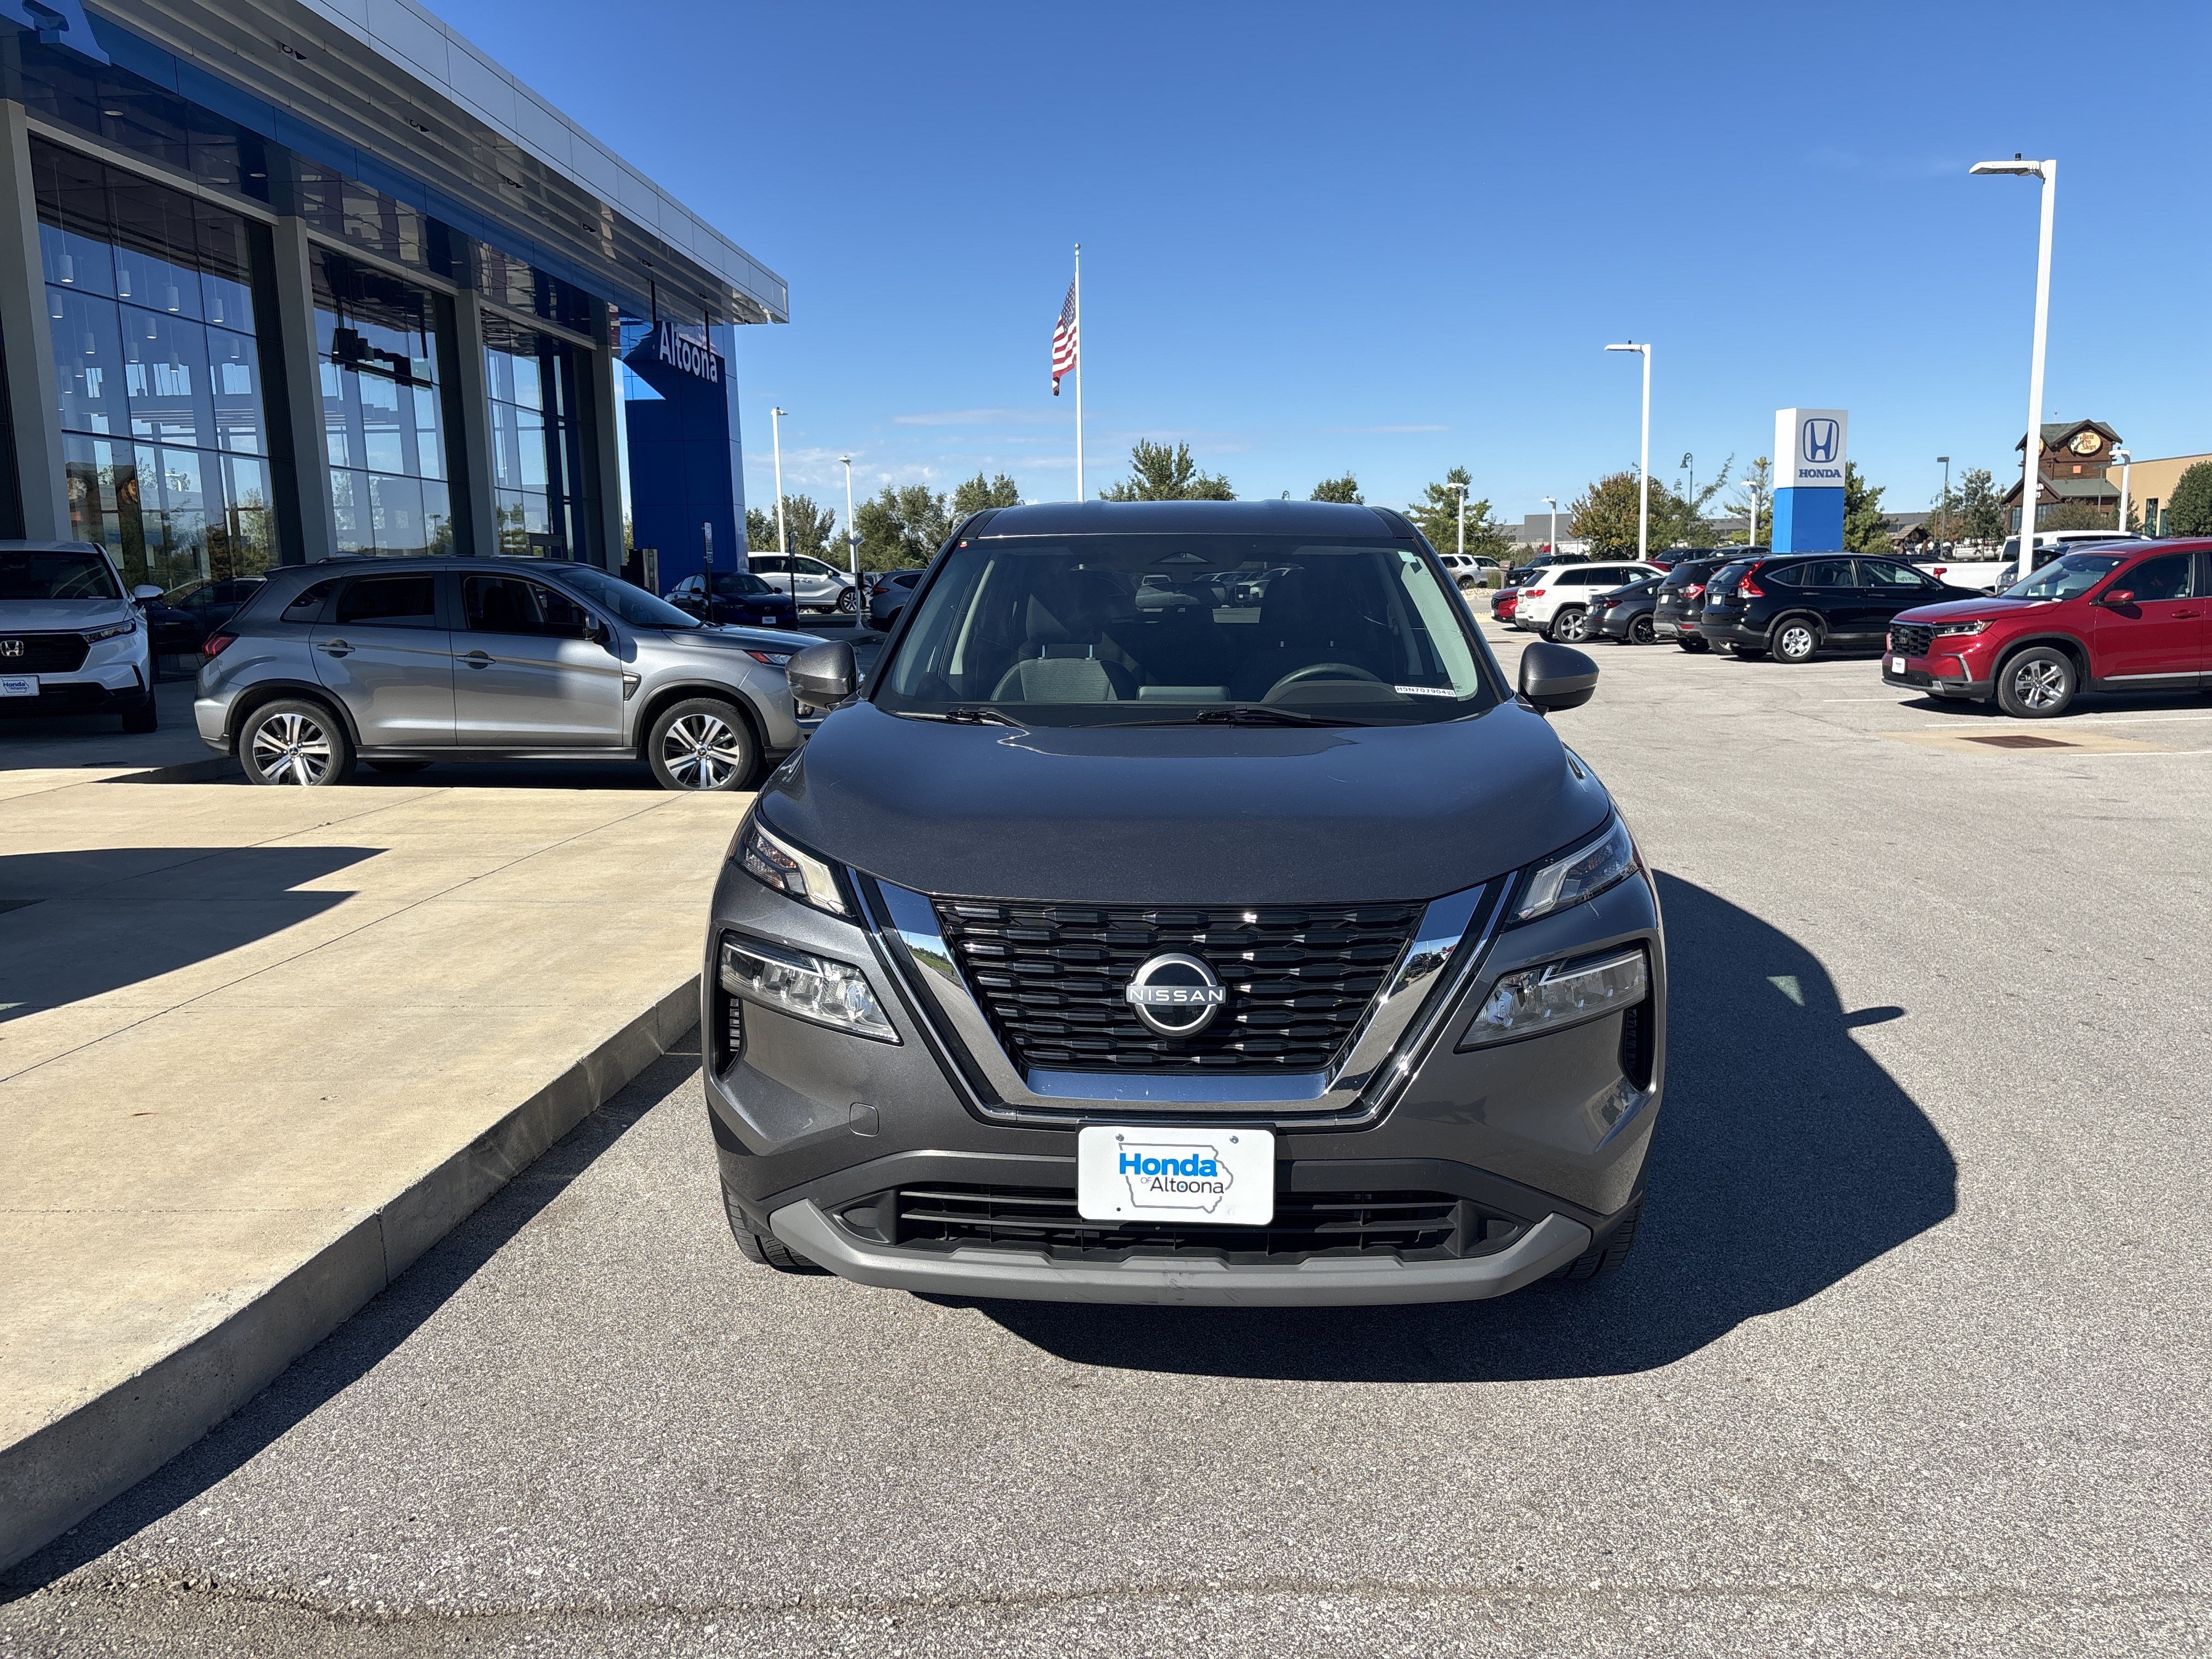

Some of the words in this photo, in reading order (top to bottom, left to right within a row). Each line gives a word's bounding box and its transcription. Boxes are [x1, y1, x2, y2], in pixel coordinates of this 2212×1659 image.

[659, 321, 718, 383] Altoona
[1798, 469, 1842, 478] HONDA
[1130, 989, 1223, 1002] NISSAN
[1119, 1153, 1217, 1177] Honda
[1150, 1176, 1224, 1194] Altoona
